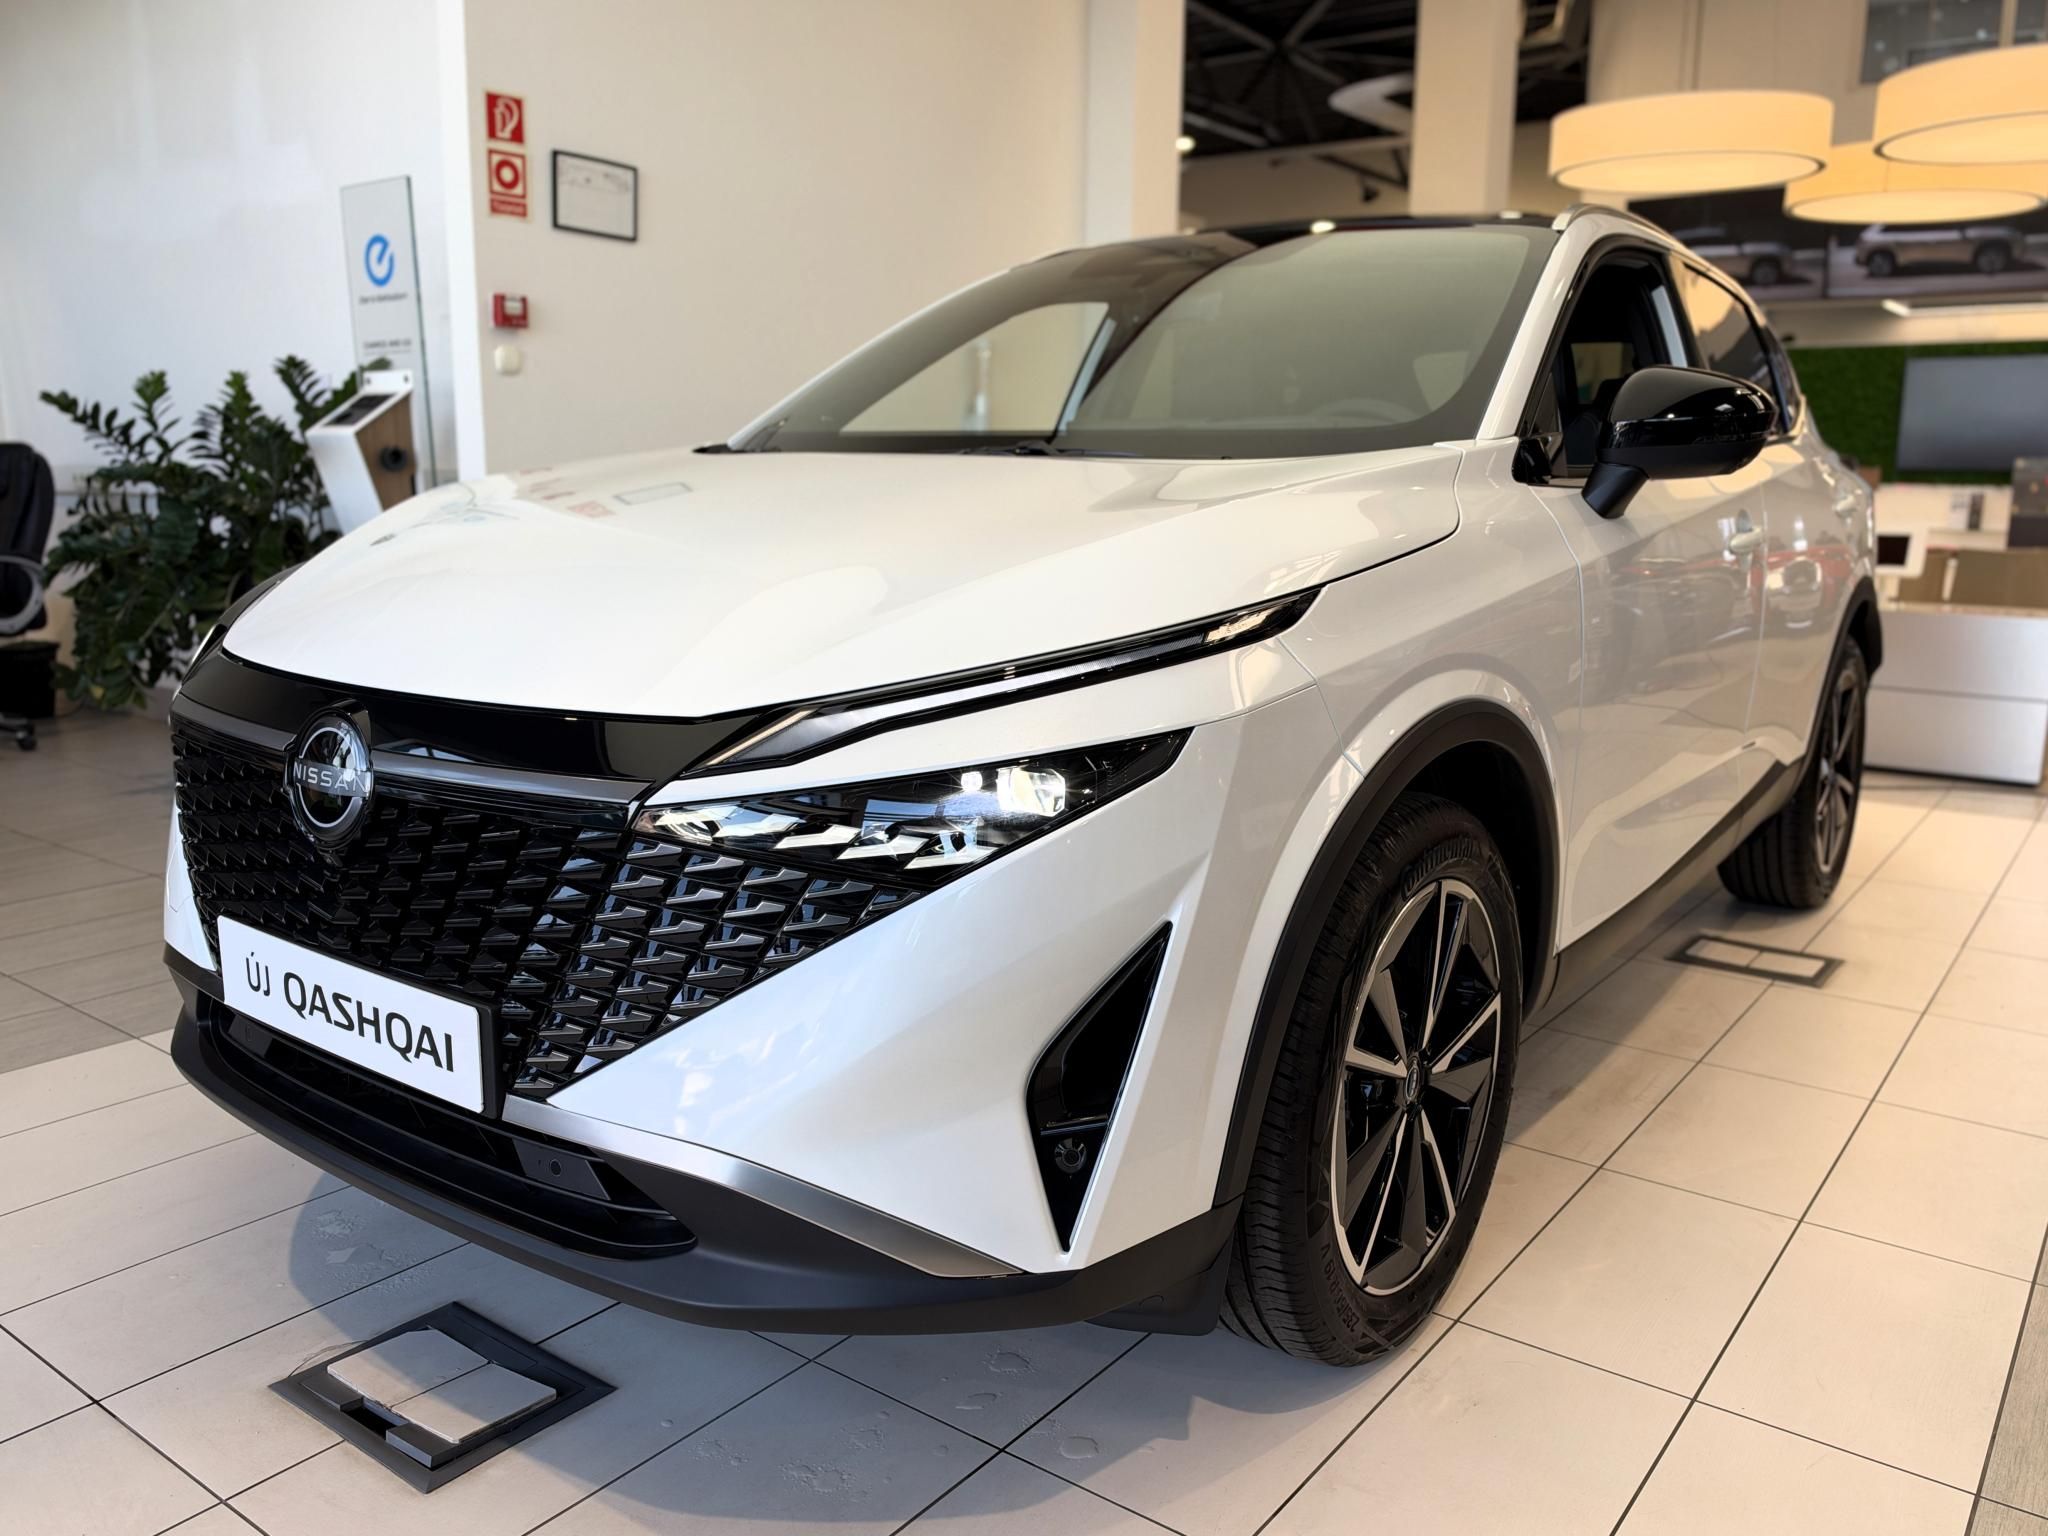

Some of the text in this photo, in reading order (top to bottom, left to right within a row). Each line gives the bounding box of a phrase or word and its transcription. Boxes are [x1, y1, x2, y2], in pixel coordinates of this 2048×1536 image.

[293, 761, 369, 793] NISSAN
[245, 952, 454, 1072] ÚJ QASHQAI
